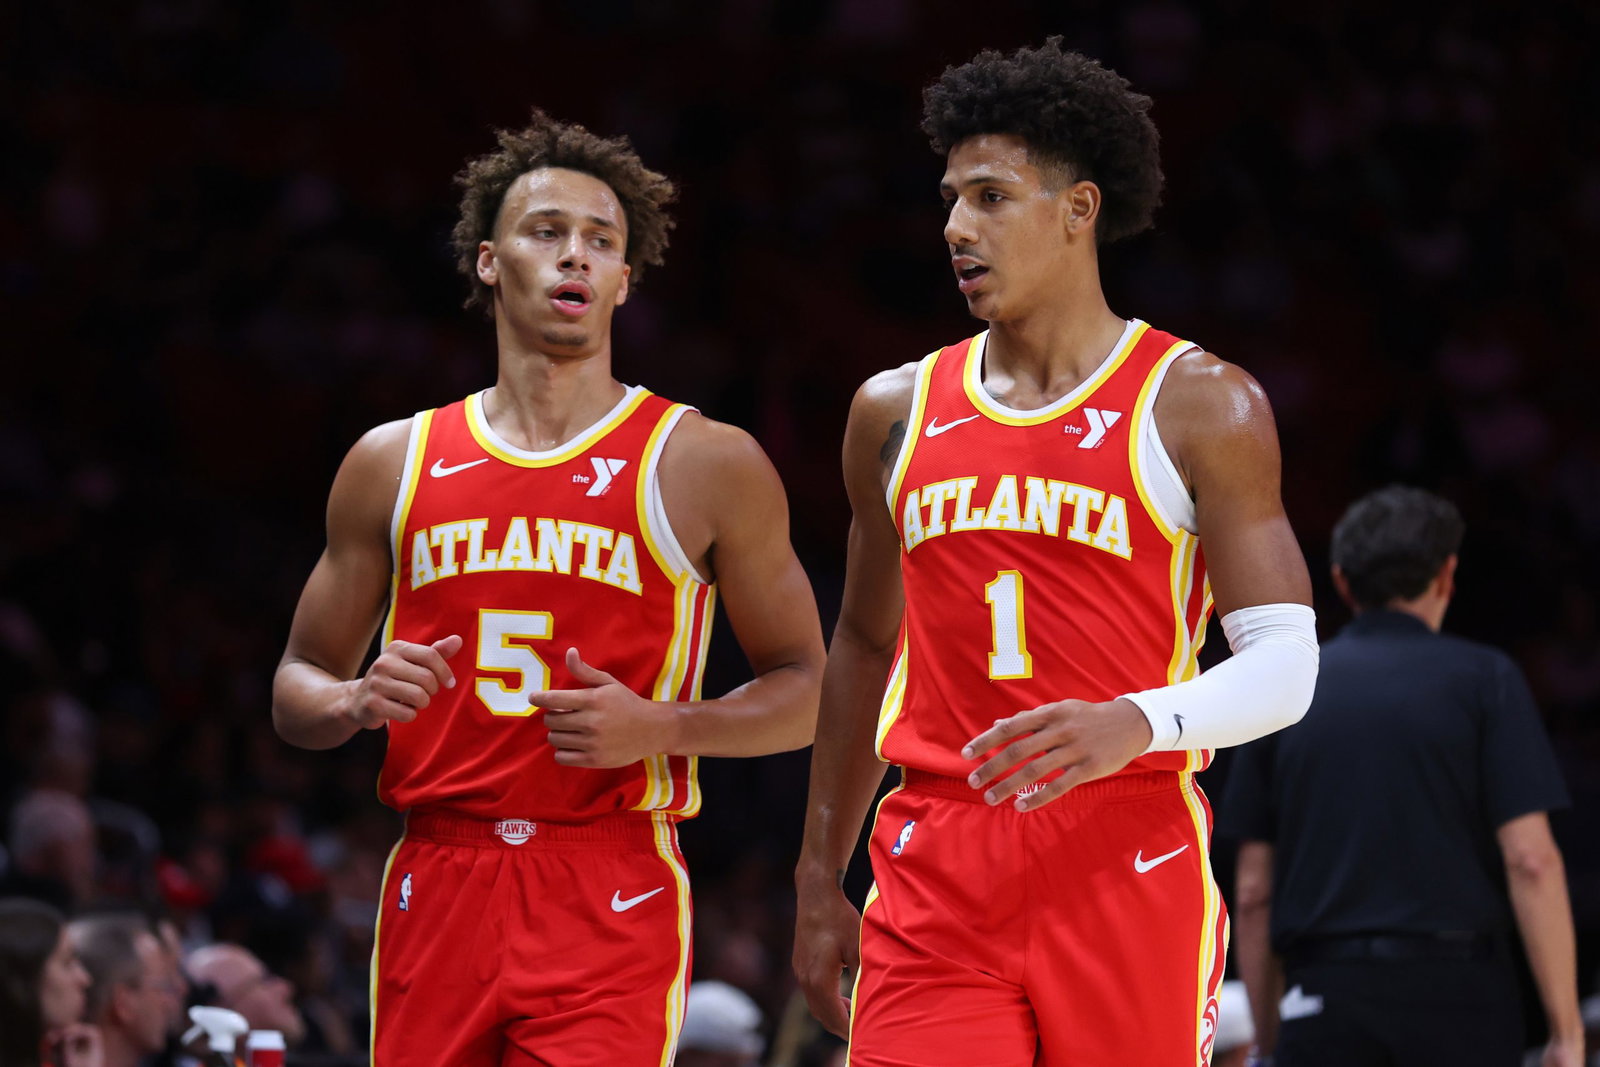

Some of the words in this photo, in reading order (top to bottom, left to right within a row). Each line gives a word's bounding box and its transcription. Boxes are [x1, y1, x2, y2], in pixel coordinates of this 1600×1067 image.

[1064, 424, 1082, 435] the
[572, 473, 590, 484] the
[903, 474, 1133, 561] ATLANTA
[411, 517, 643, 596] ATLANTA
[475, 608, 554, 717] 5
[985, 569, 1032, 679] 1
[495, 822, 536, 835] HAWKS
